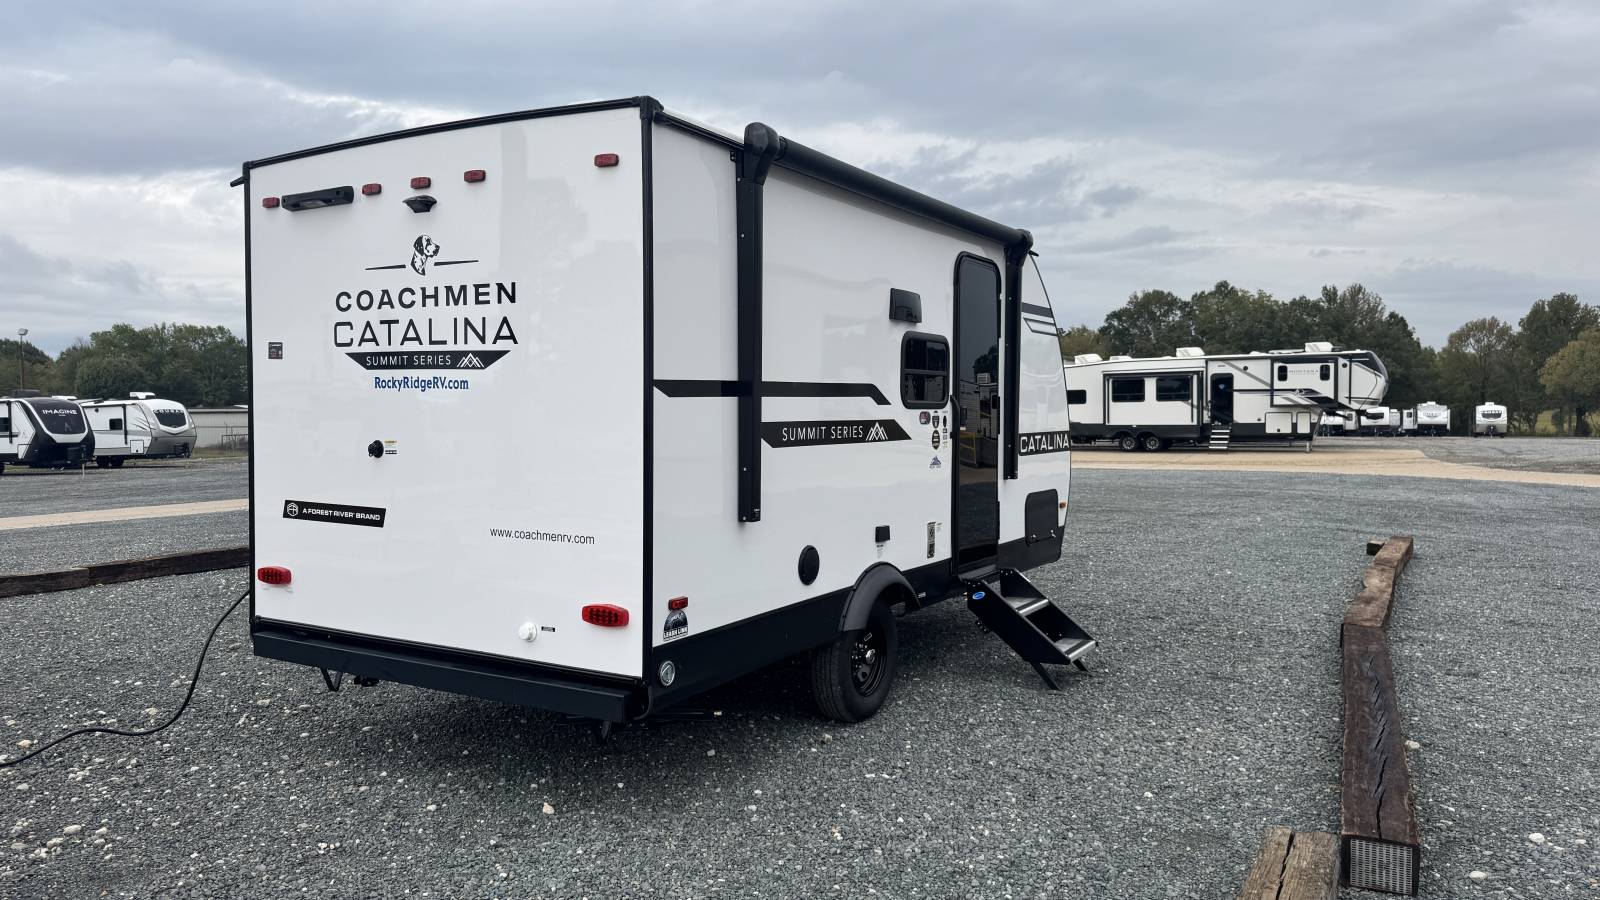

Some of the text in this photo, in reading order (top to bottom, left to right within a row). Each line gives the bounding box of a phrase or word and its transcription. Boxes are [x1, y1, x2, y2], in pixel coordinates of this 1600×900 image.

[335, 281, 517, 313] COACHMEN
[333, 316, 519, 348] CATALINA
[366, 354, 451, 367] SUMMIT SERIES
[374, 376, 469, 392] RockyRidgeRV.com
[782, 425, 864, 442] SUMMIT SERIES
[1019, 433, 1070, 453] CATALINA
[308, 508, 333, 516] FOREST
[356, 512, 381, 521] BRAND
[489, 527, 595, 545] www.coachmenrv.com
